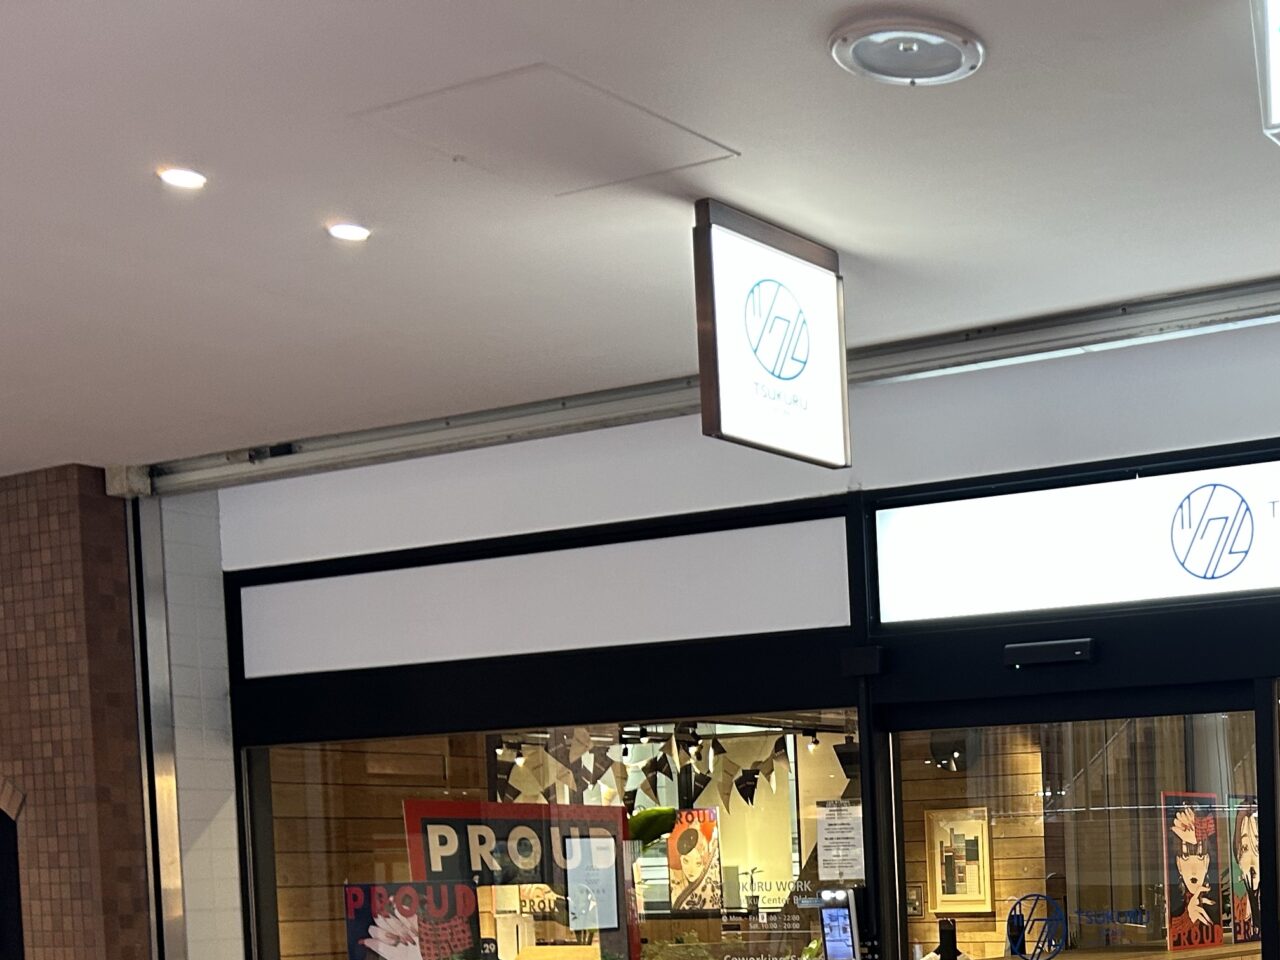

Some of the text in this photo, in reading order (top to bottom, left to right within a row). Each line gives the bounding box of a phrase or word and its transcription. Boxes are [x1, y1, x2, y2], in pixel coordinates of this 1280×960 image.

[677, 810, 716, 823] ROUD
[426, 824, 616, 872] PROUD
[776, 880, 812, 892] WORK
[345, 884, 476, 919] PROUD
[520, 899, 560, 913] PROU
[1172, 924, 1224, 945] PROUD
